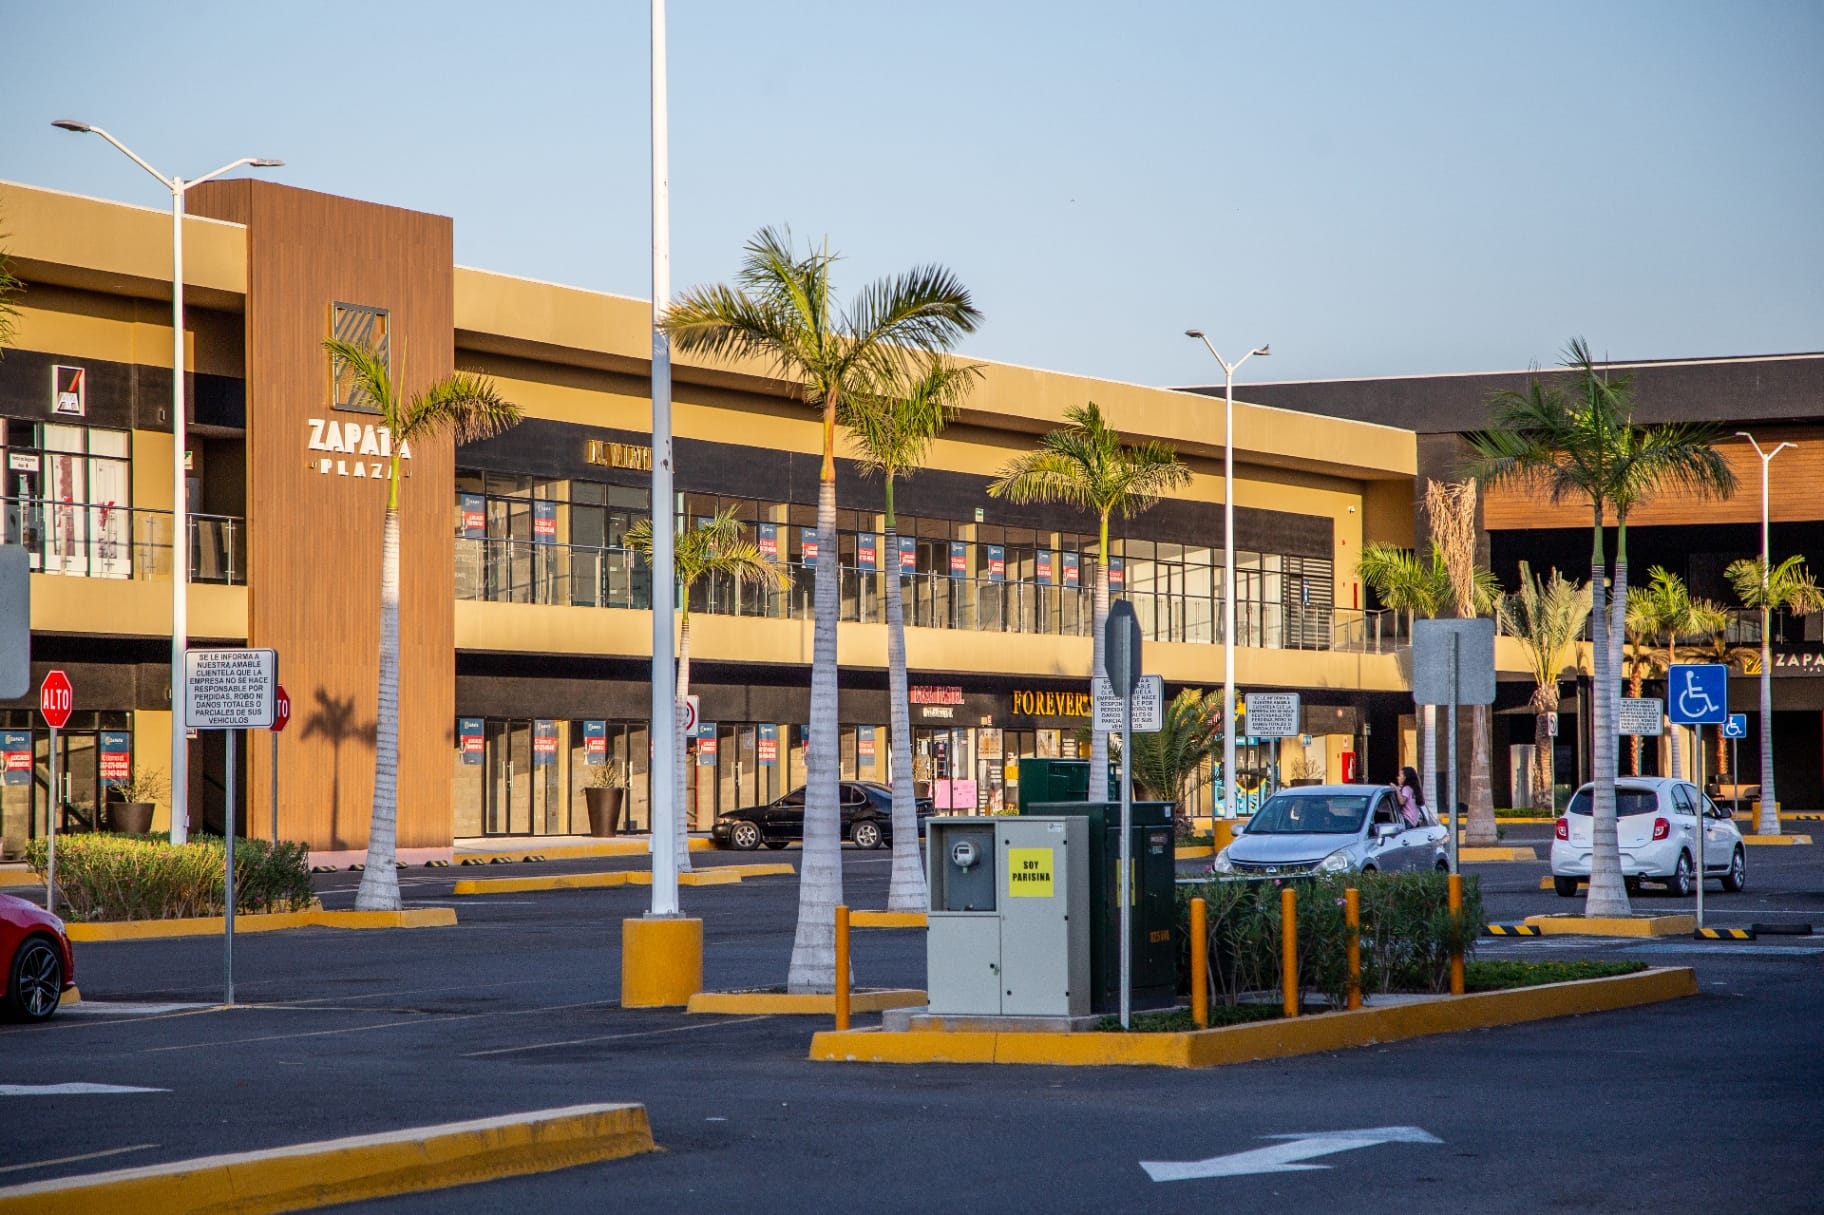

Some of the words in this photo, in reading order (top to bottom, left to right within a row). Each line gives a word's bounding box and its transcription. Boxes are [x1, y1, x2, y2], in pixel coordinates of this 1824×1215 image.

[308, 418, 412, 459] ZAPATA
[210, 653, 219, 661] LE
[197, 661, 230, 669] NUESTRA
[231, 660, 262, 668] AMABLE
[196, 669, 235, 677] CLIENTELA
[236, 669, 251, 677] QUE
[189, 677, 224, 685] EMPRESA
[237, 676, 247, 684] SE
[248, 676, 268, 684] HACE
[194, 685, 247, 693] RESPONSABLE
[248, 684, 264, 692] POR
[43, 688, 70, 710] ALTO
[233, 692, 255, 700] ROBO
[256, 692, 263, 700] NI
[222, 700, 255, 709] TOTALES
[255, 700, 262, 708] O
[276, 699, 288, 718] TO
[195, 709, 235, 717] PARCIALES
[247, 708, 262, 716] SUS
[208, 716, 249, 724] VEHICULOS
[1023, 860, 1039, 870] SOY
[1012, 872, 1051, 882] PARISINA
